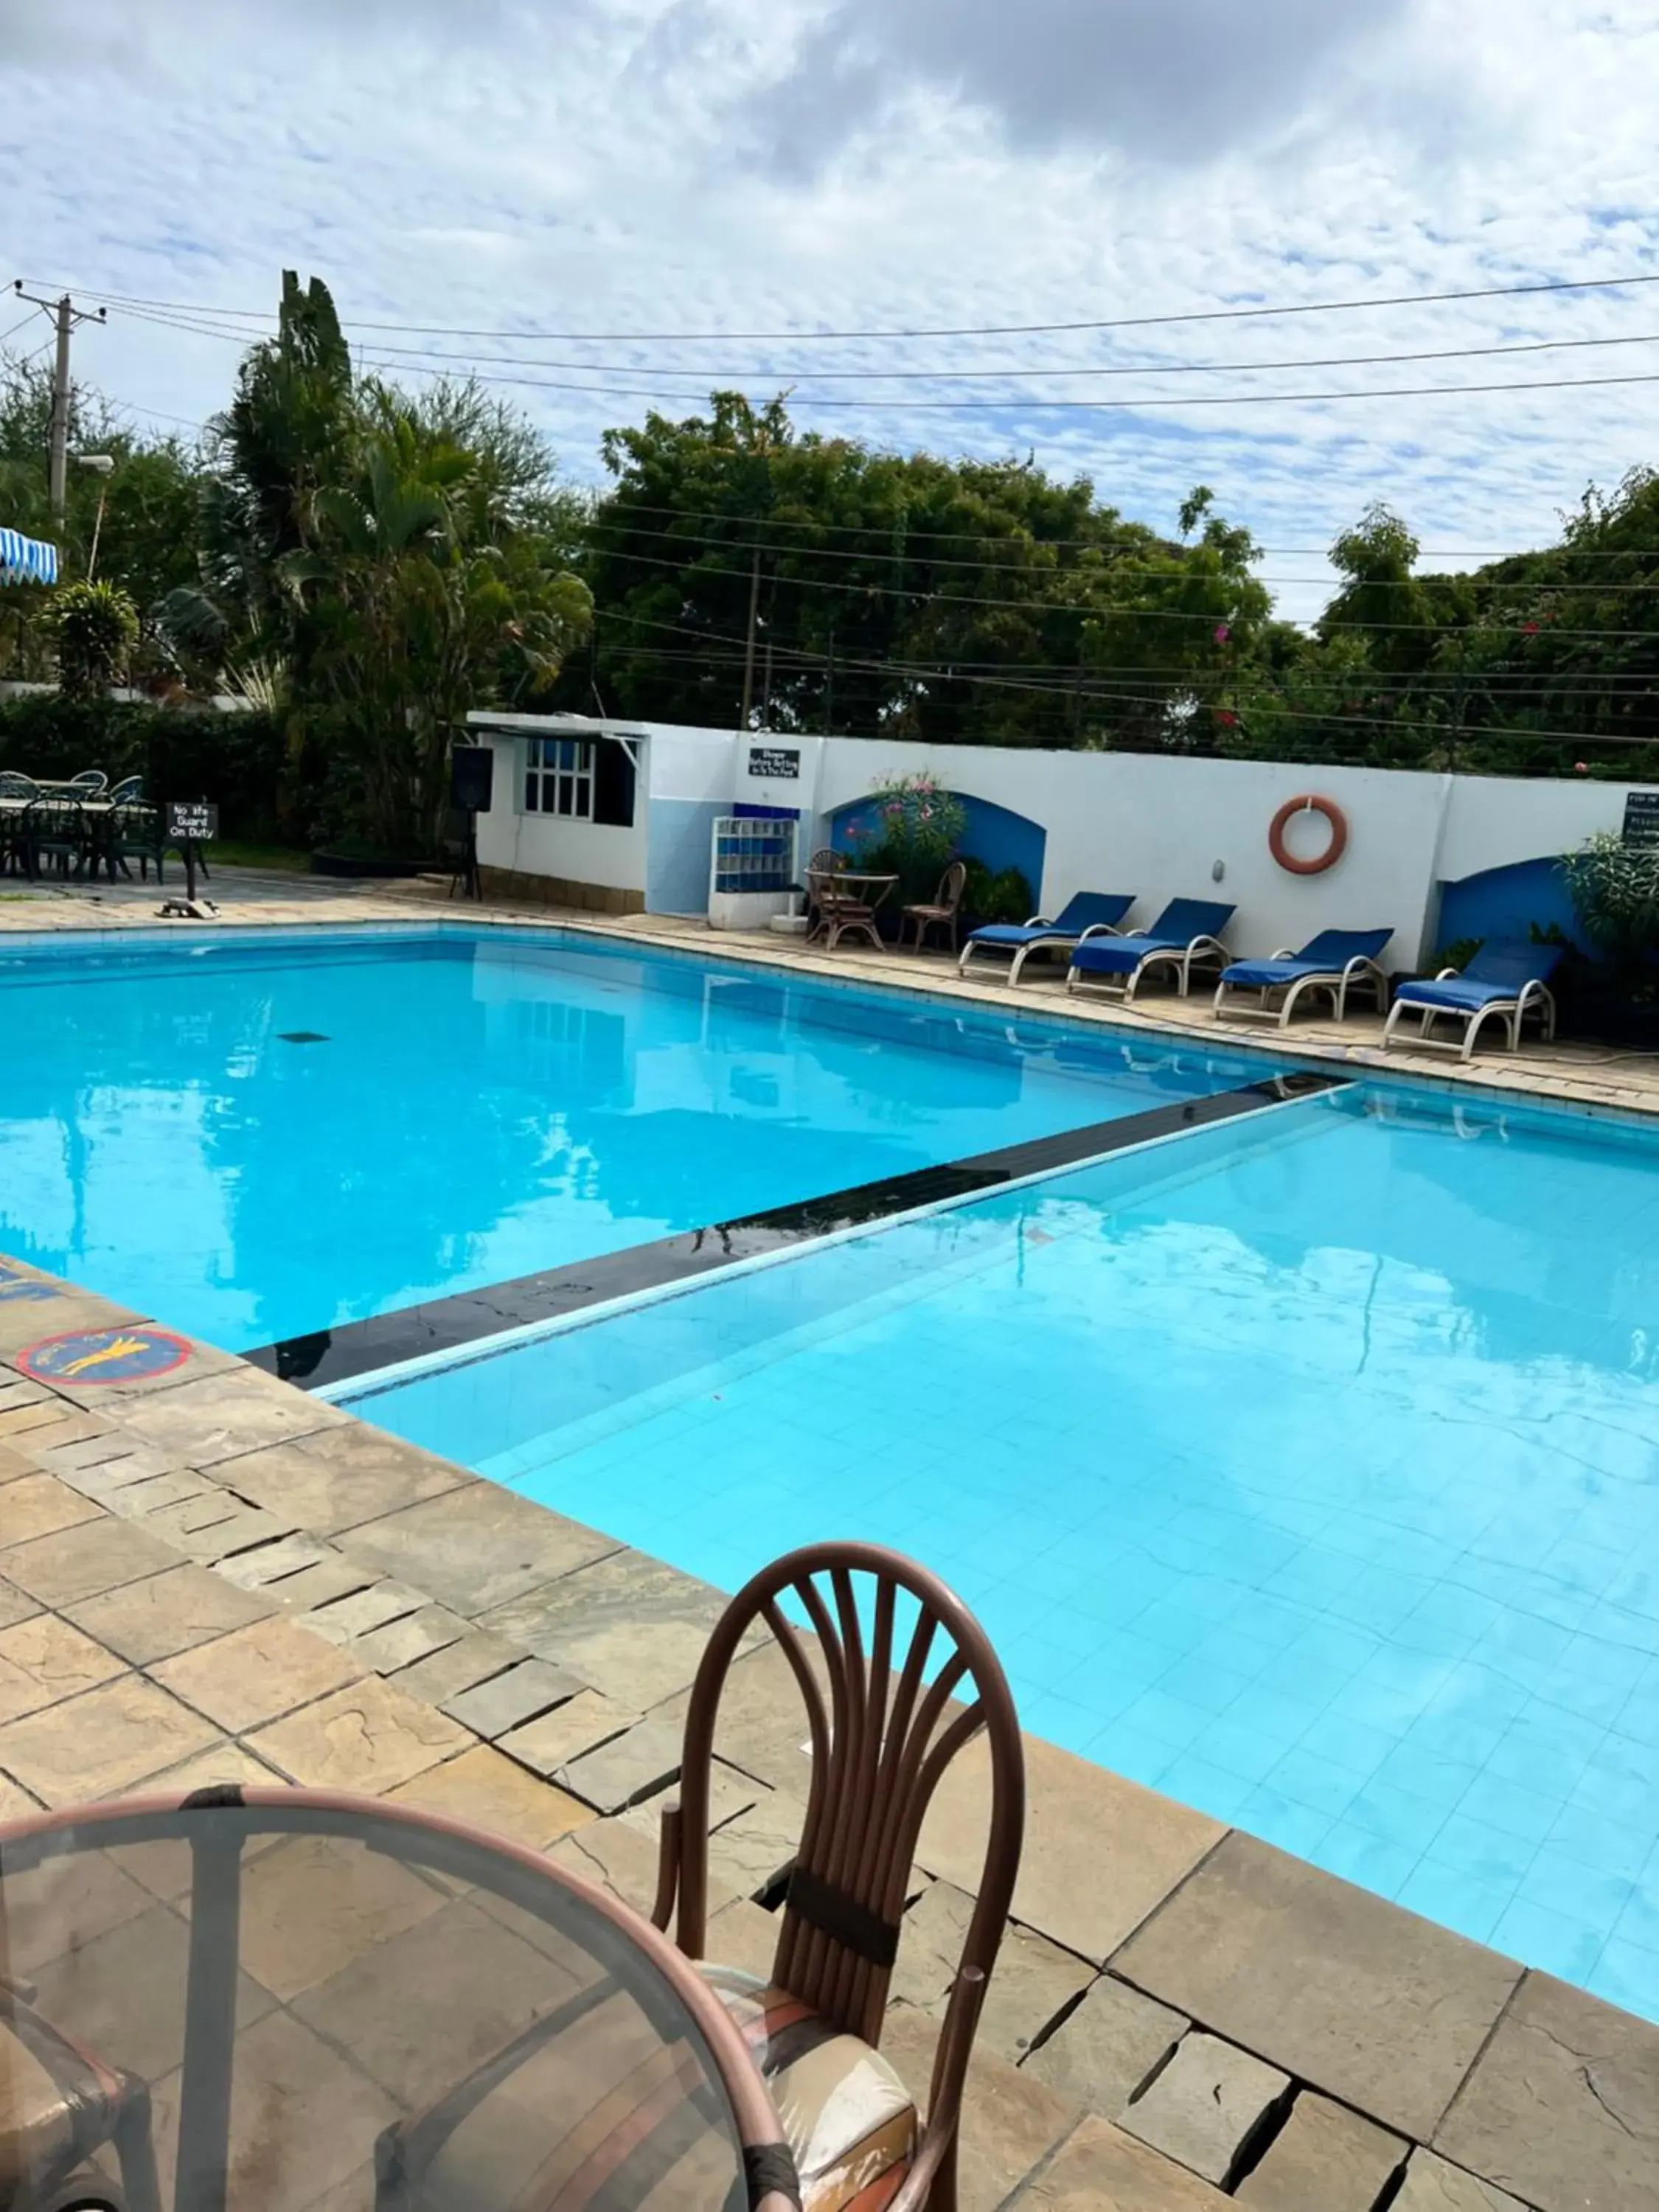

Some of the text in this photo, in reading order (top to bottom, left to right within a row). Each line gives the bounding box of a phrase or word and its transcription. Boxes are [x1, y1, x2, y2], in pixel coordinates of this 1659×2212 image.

[173, 805, 187, 815] No
[177, 815, 208, 827] Guard
[170, 827, 214, 839] On Duty
